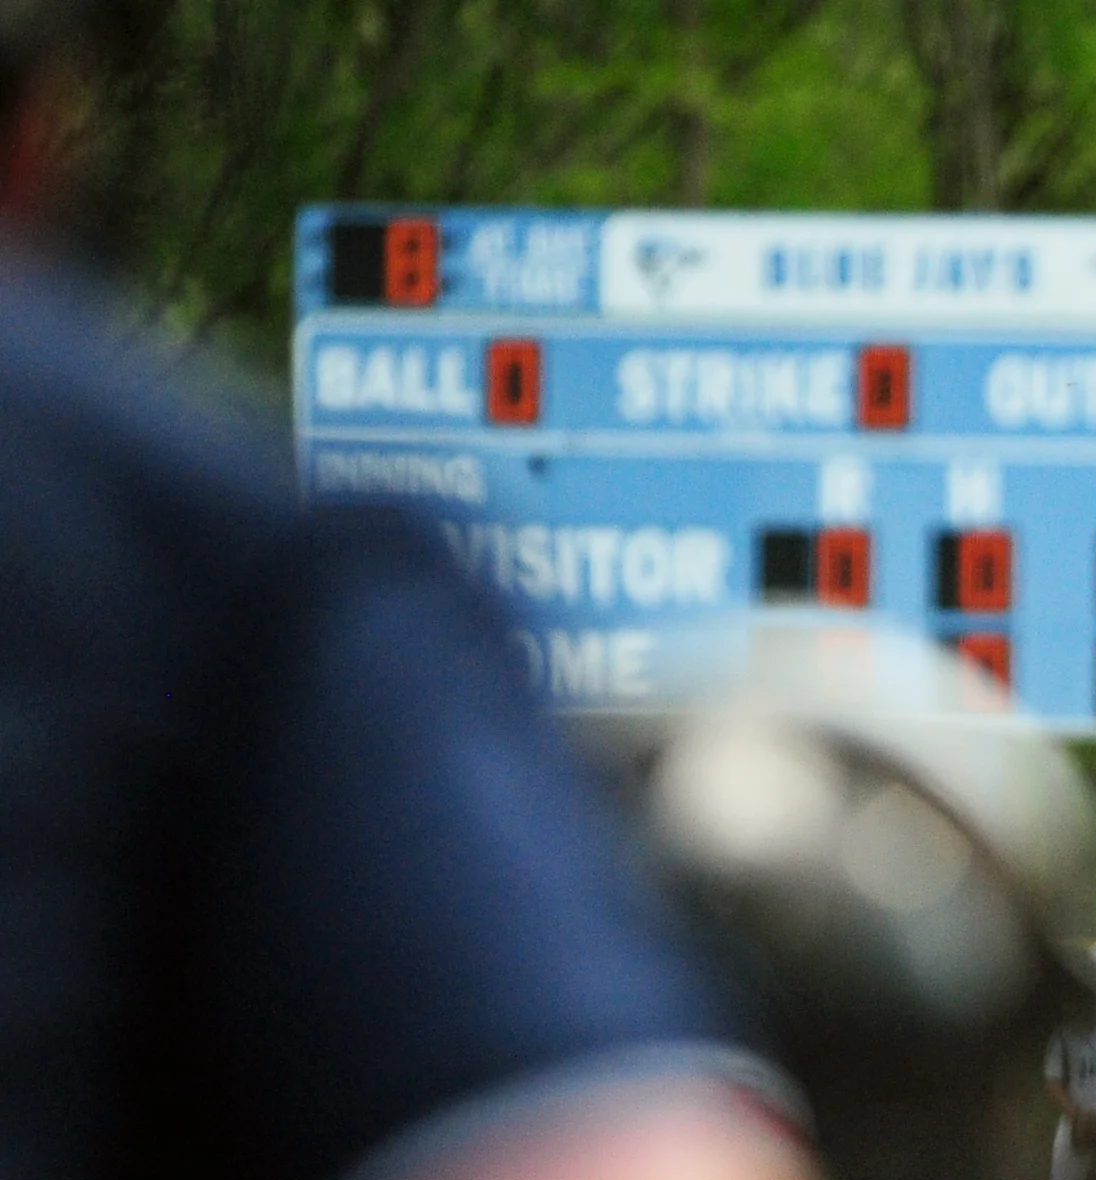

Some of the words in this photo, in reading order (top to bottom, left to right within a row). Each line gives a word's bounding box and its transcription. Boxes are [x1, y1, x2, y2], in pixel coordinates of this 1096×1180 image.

[762, 245, 885, 288] BLUE
[914, 247, 1033, 290] JAYS
[316, 344, 478, 417] BALL
[487, 340, 540, 423] 0
[618, 349, 848, 423] STRIKE
[438, 520, 732, 605] VISITOR
[513, 627, 658, 697] ME
